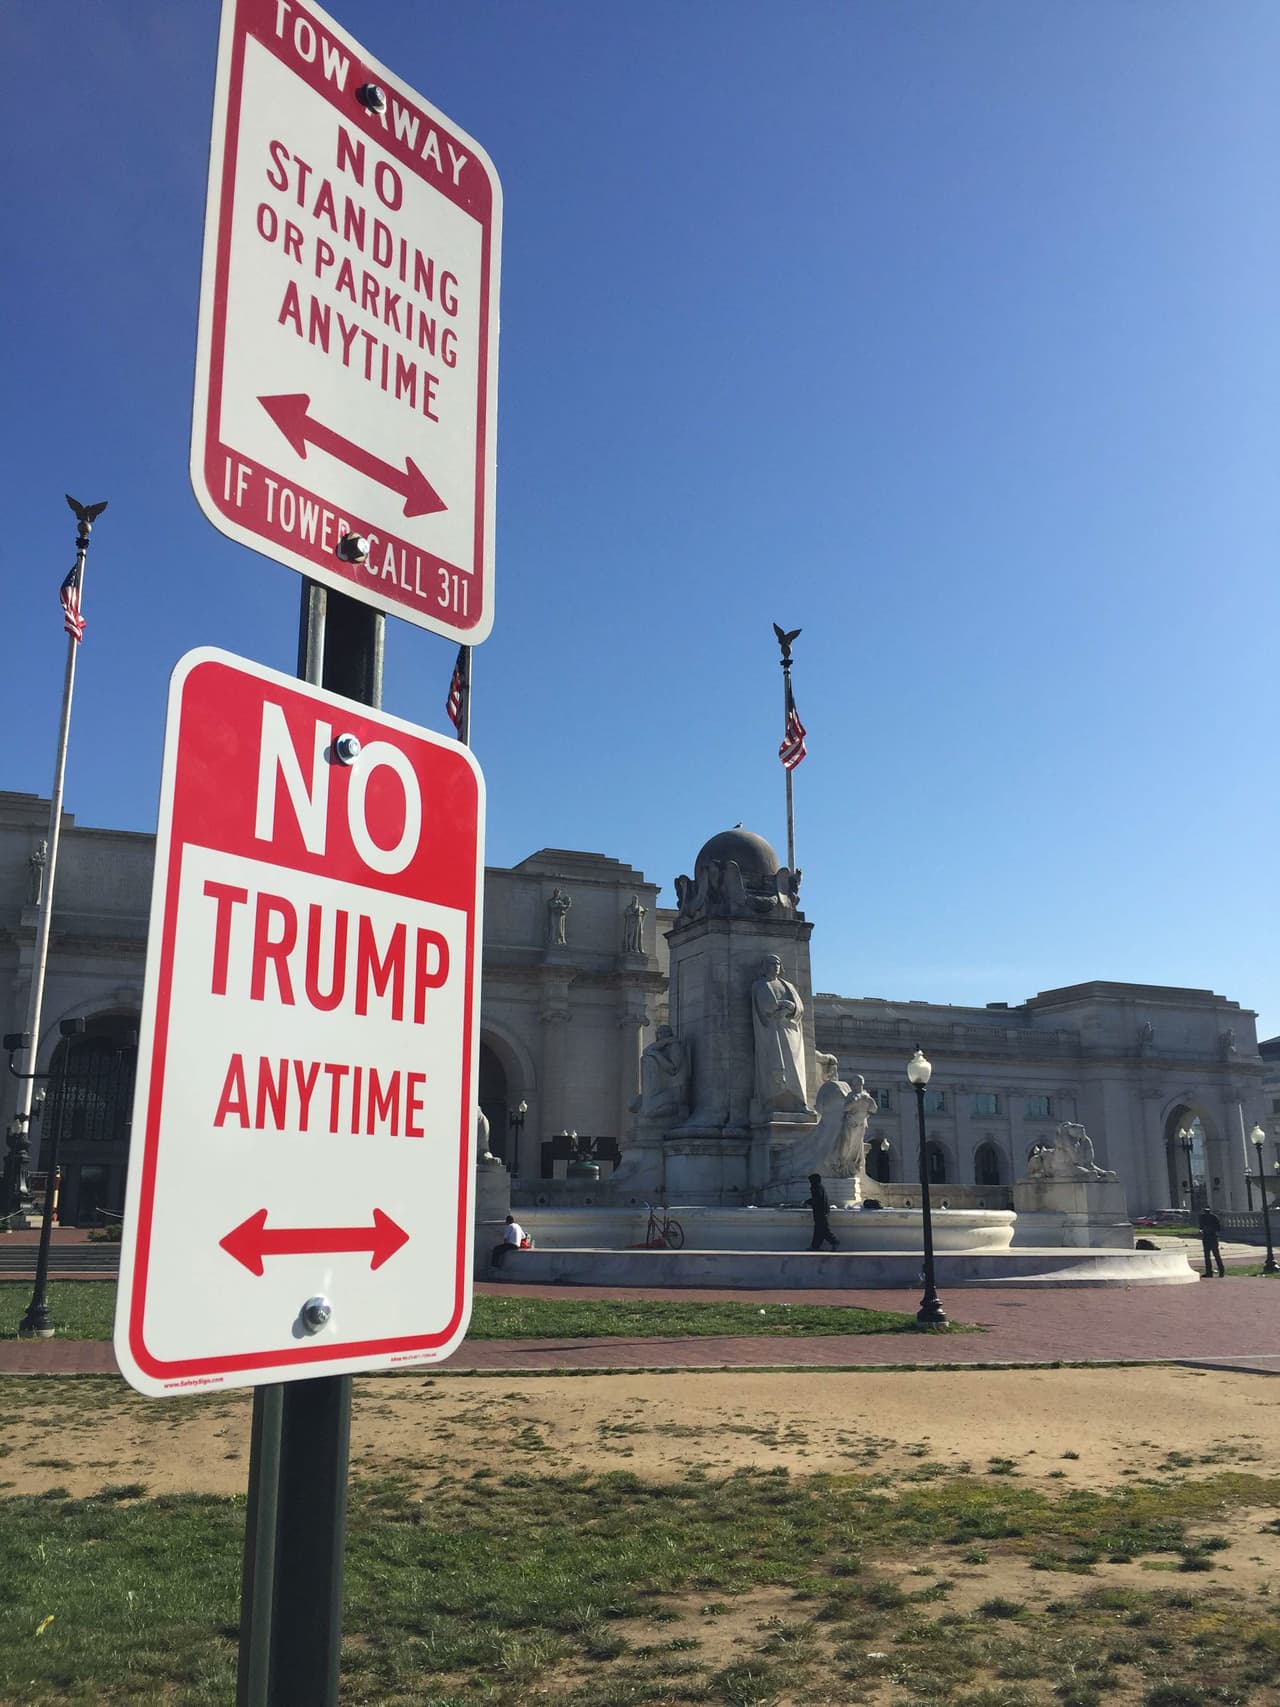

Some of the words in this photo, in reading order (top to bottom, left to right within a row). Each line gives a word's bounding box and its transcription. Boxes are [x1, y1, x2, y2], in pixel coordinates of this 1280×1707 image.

[275, 0, 350, 92] TOW
[266, 140, 458, 317] STANDING
[336, 125, 402, 212] NO
[256, 203, 304, 264] OR
[315, 237, 457, 368] PARKING
[278, 280, 439, 422] ANYTIME
[224, 457, 252, 508] IF
[364, 533, 427, 598] CALL
[437, 568, 468, 616] 311
[254, 700, 422, 875] NO
[203, 880, 450, 1024] TRUMP
[213, 1053, 426, 1138] ANYTIME
